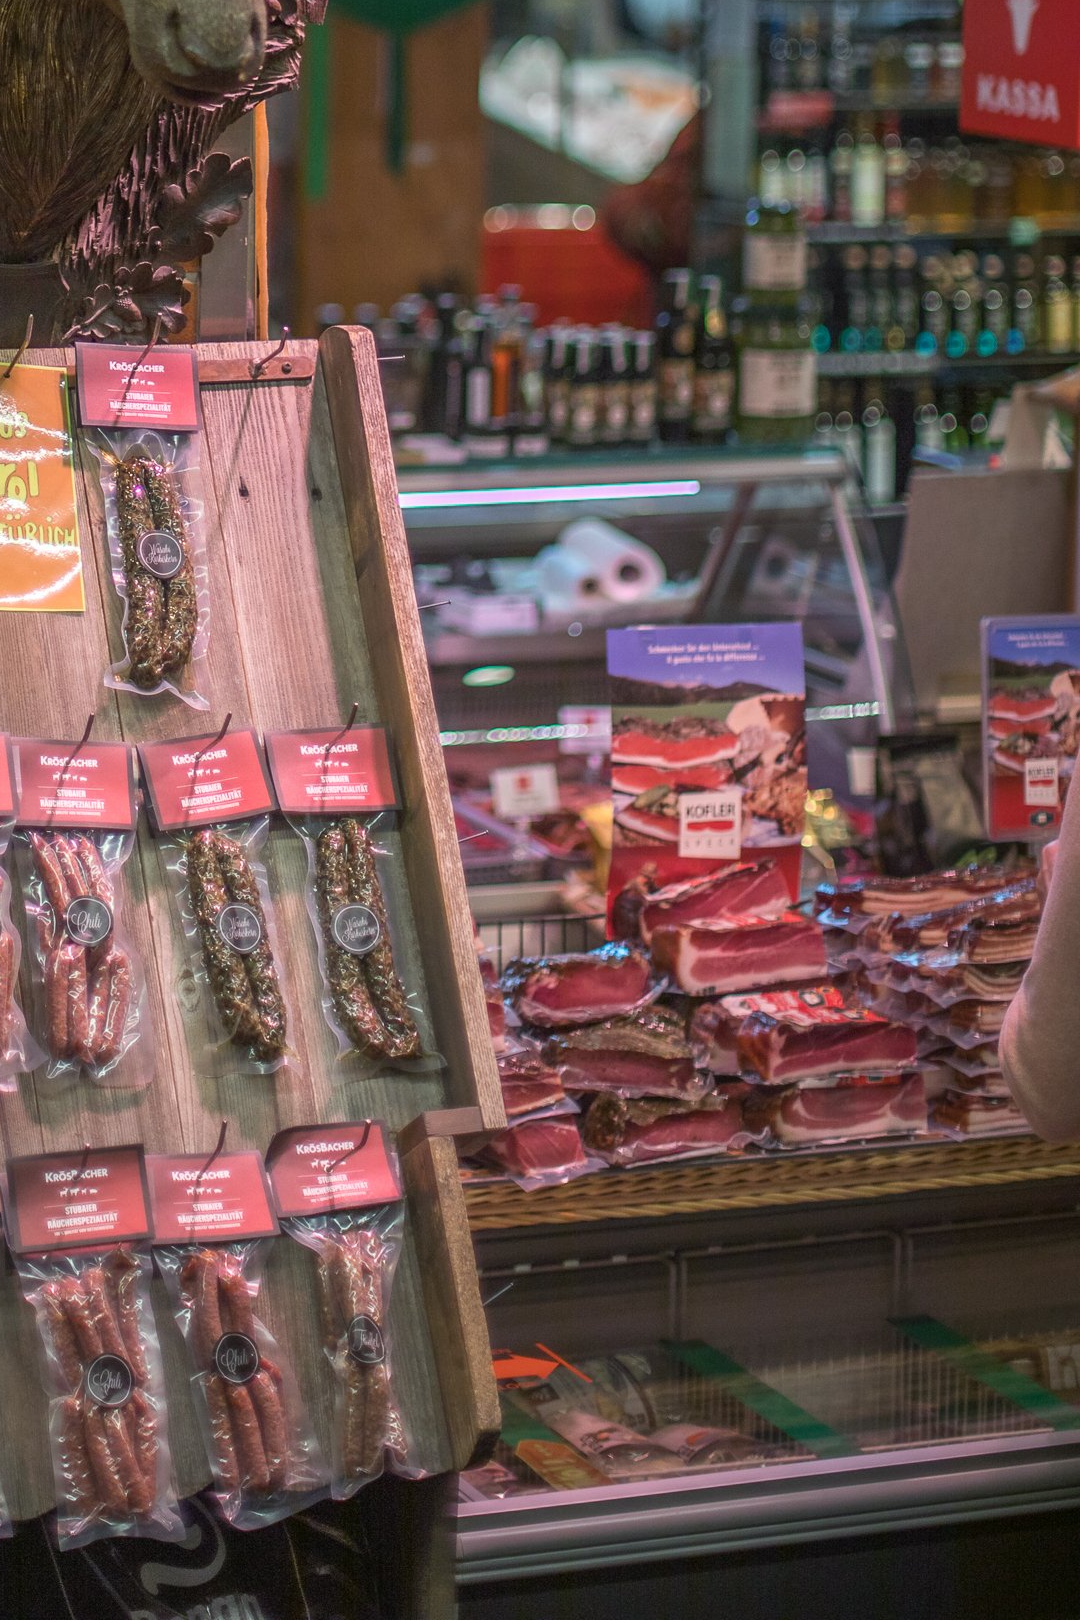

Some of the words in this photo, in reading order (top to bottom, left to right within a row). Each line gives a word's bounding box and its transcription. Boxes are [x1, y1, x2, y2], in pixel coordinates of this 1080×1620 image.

[976, 73, 1060, 123] KASSA
[686, 804, 735, 818] KOFLER
[71, 910, 102, 935] Chili
[221, 1348, 248, 1375] Chili
[93, 1368, 123, 1396] Chili
